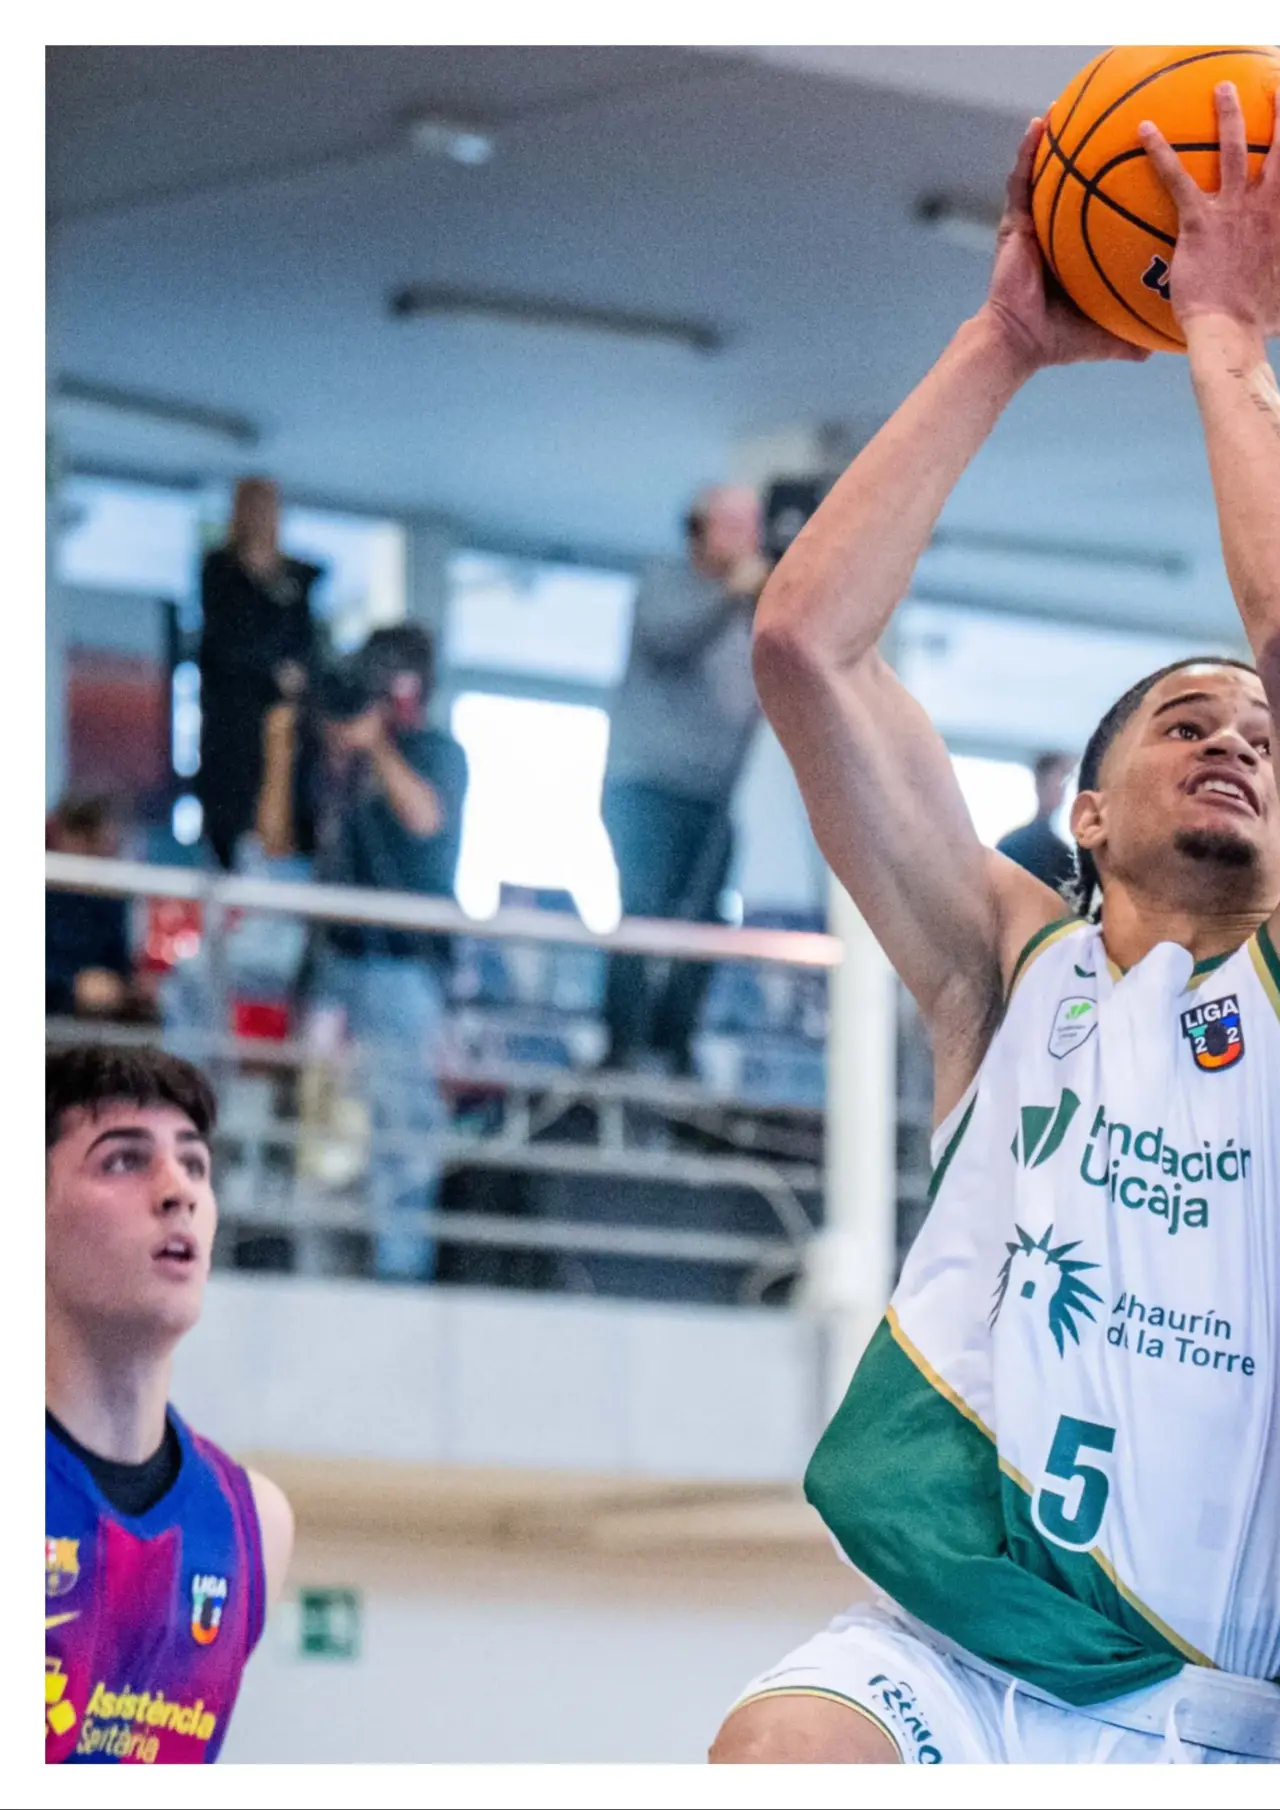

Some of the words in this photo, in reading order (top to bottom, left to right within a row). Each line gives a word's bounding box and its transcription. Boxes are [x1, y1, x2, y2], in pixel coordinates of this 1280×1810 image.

[1184, 998, 1240, 1029] LIGA
[1080, 1143, 1209, 1236] Uicaja
[1112, 1292, 1232, 1341] Ahaurín
[1136, 1329, 1165, 1359] la
[1175, 1336, 1256, 1377] Torre
[1033, 1412, 1118, 1549] 5
